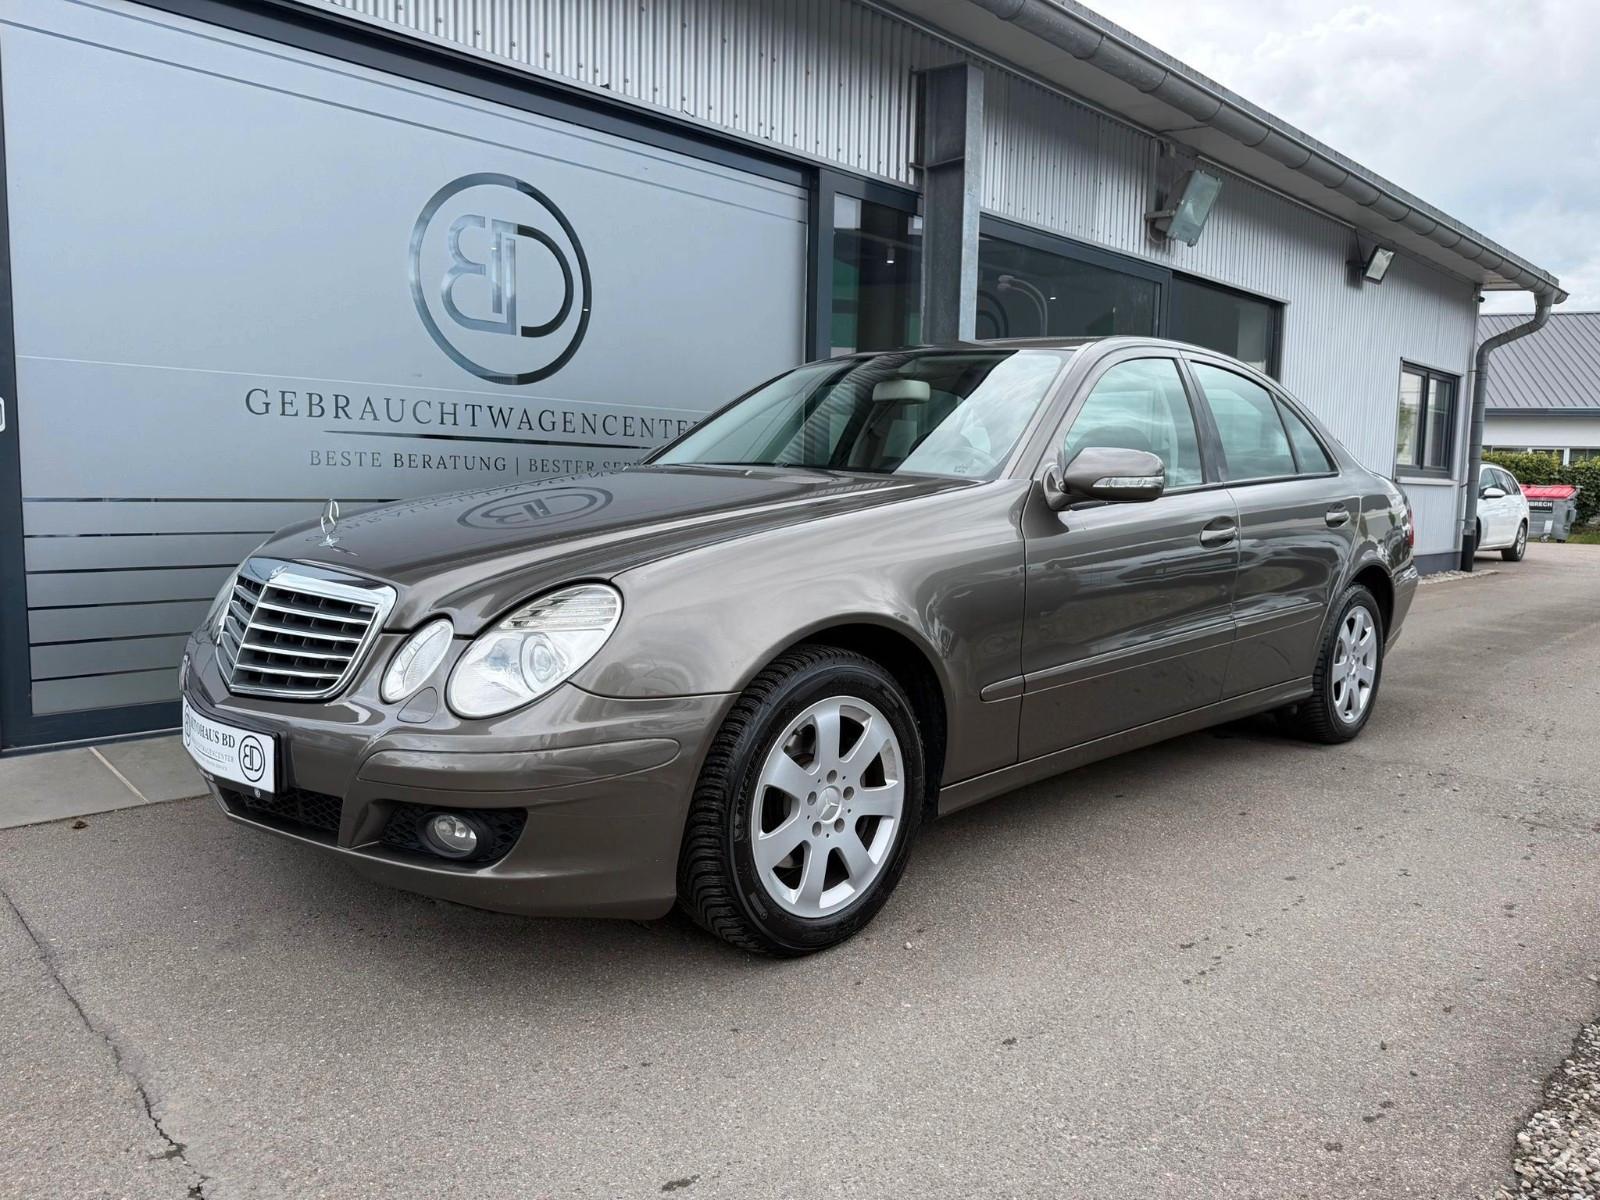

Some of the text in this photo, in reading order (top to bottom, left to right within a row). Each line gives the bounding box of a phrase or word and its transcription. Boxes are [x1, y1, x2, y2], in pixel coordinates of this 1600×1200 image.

[309, 450, 382, 467] BESTE
[394, 453, 506, 471] BERATUNG
[529, 458, 594, 474] BESTER
[222, 733, 235, 748] BD
